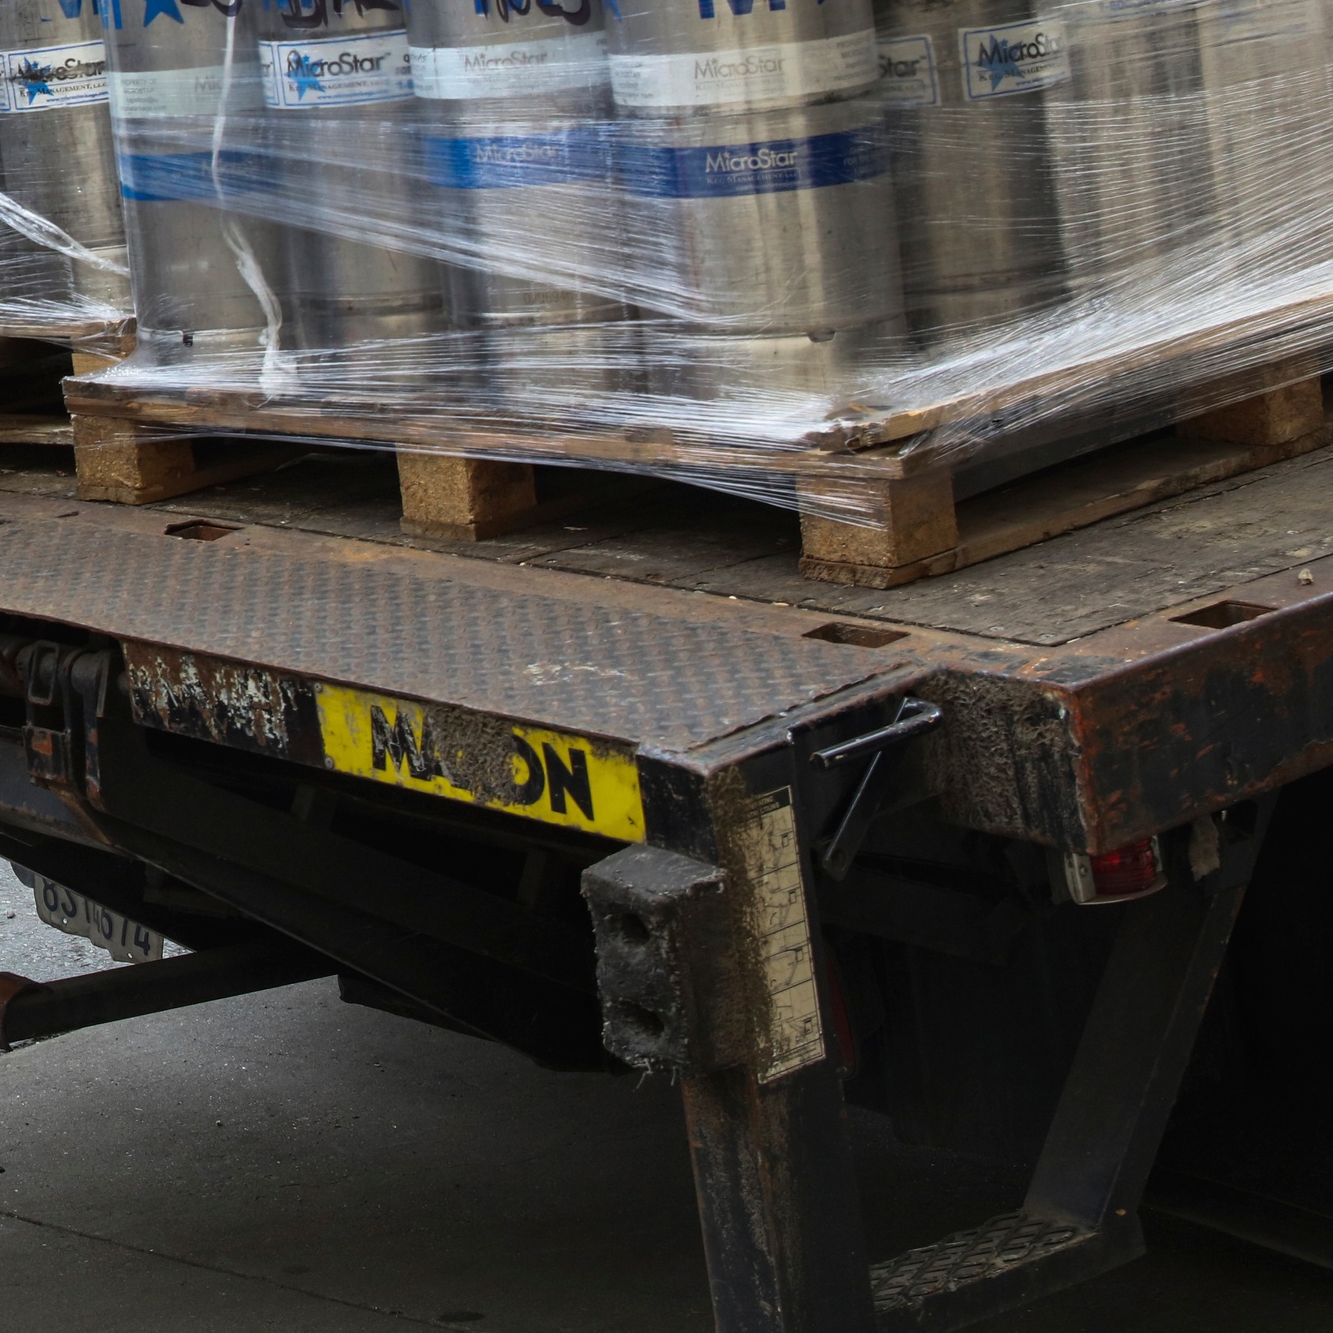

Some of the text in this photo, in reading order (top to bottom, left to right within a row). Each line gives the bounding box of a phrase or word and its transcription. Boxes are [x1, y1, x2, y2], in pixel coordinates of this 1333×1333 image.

[286, 51, 385, 78] MicroStar
[694, 56, 784, 81] MicroStar
[705, 148, 798, 173] MicroStar
[370, 703, 595, 822] MON
